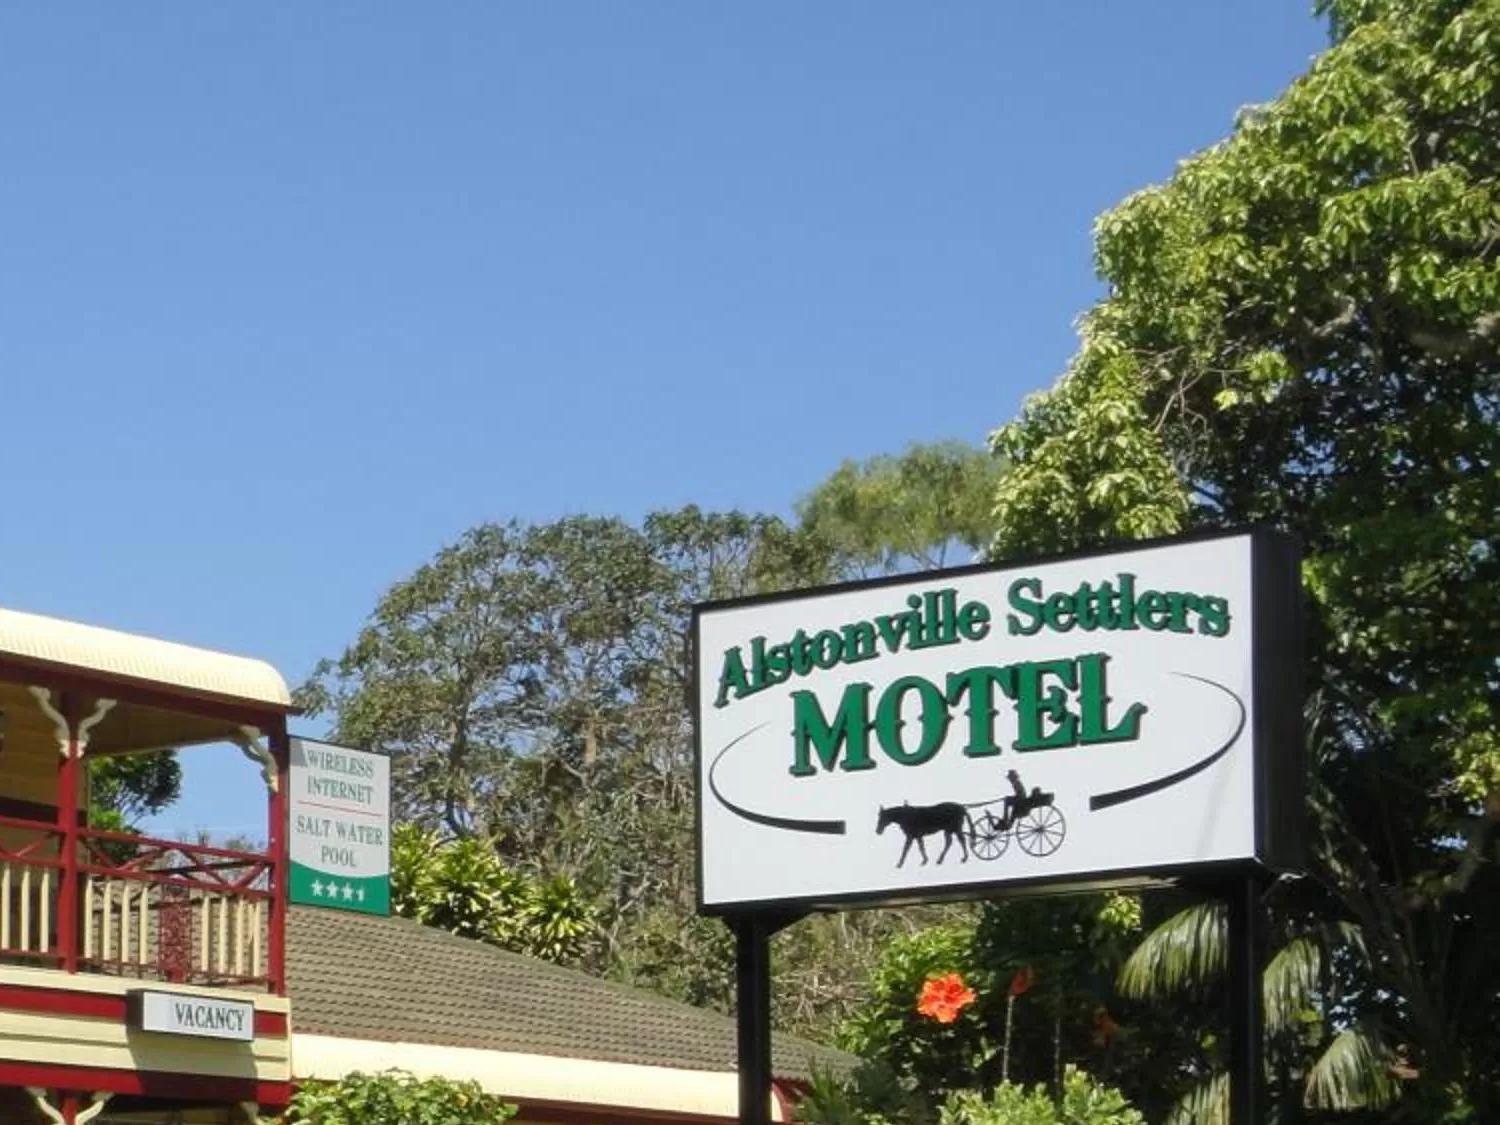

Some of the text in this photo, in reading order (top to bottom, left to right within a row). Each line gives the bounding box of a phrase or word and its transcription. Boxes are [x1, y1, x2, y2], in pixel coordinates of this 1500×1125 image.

[713, 572, 1233, 708] Alstonville Settlers
[789, 652, 1148, 776] MOTEL
[307, 750, 374, 779] WIRELESS
[307, 775, 374, 805] INTERNET
[297, 815, 383, 846] SALT WATER
[321, 845, 357, 867] POOL
[175, 1003, 244, 1031] VACANCY
